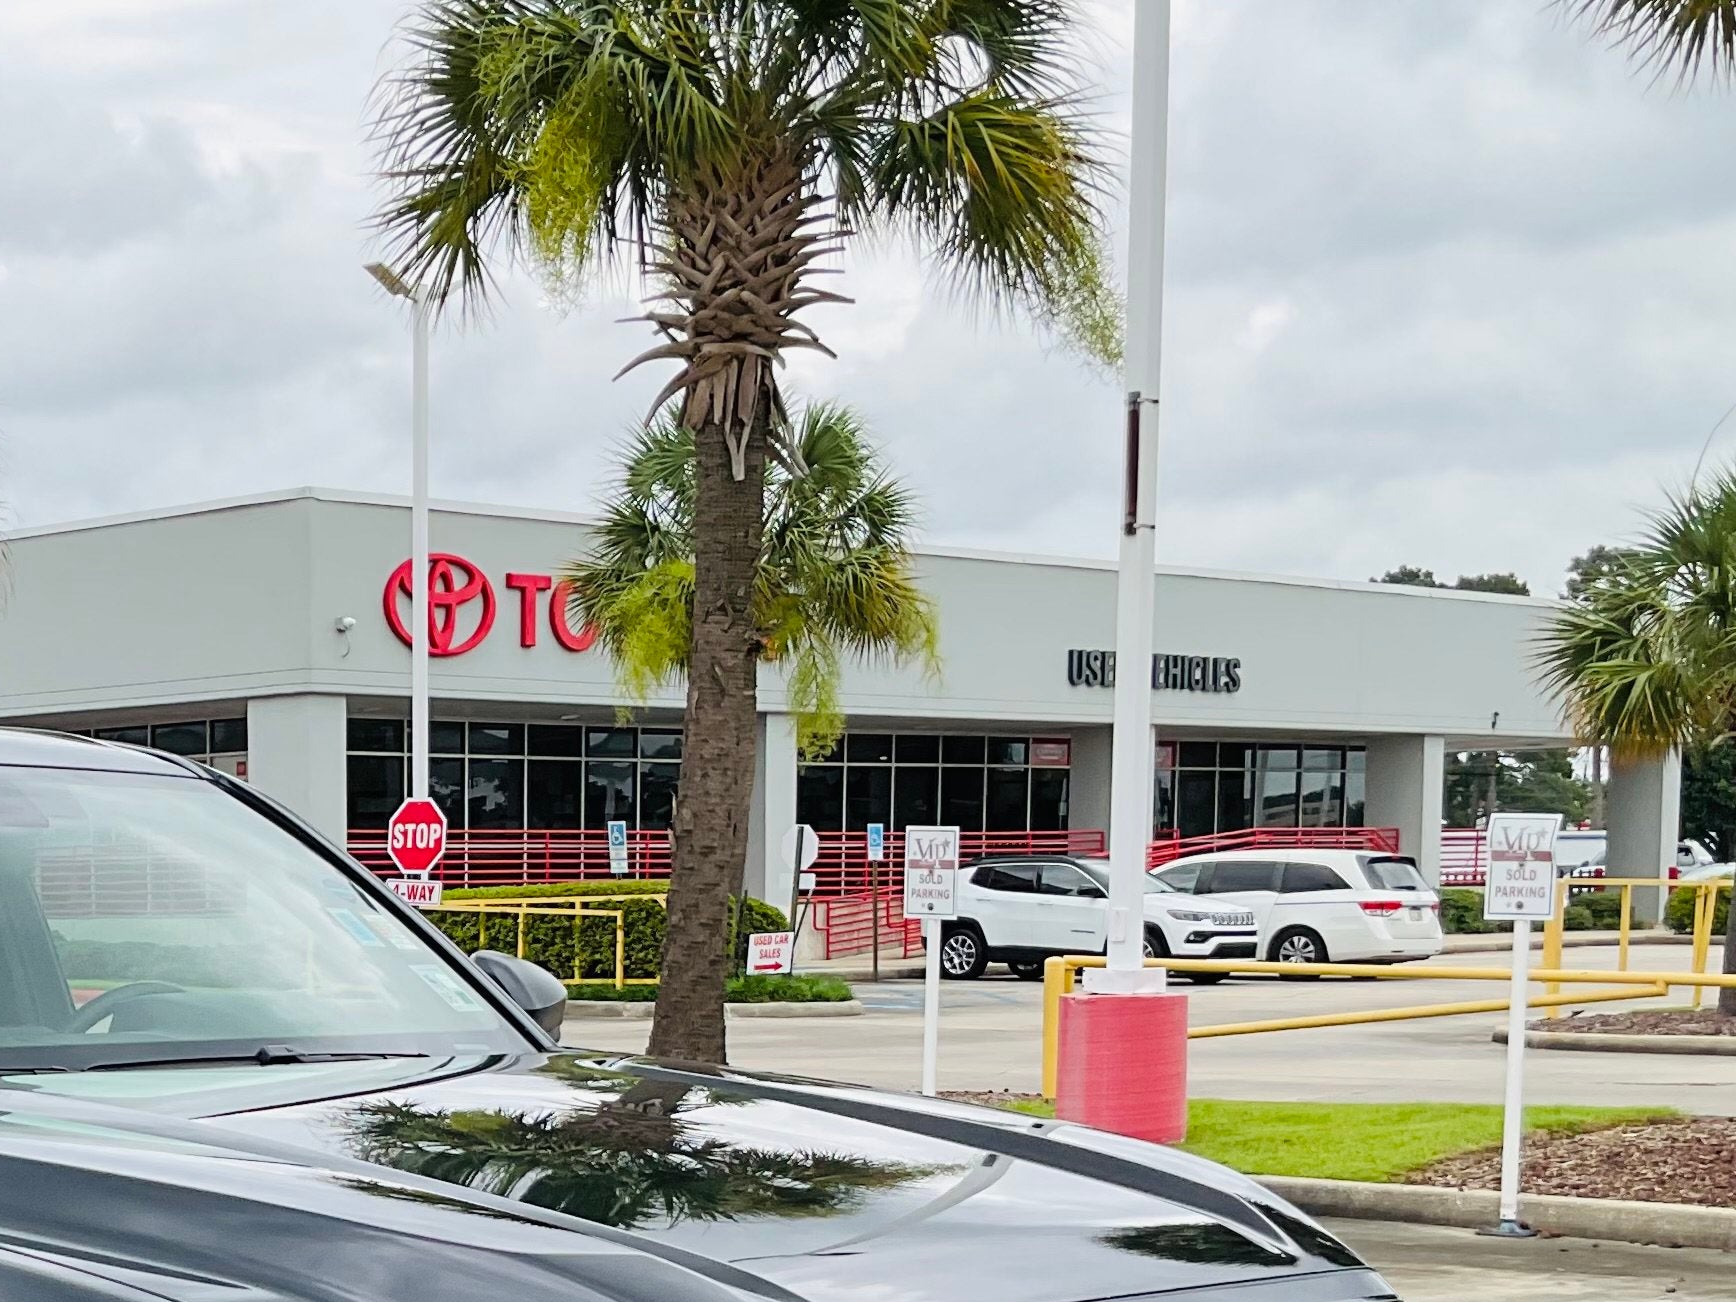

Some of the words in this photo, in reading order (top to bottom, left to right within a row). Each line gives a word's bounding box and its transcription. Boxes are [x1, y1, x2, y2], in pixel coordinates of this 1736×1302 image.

[1067, 649, 1117, 687] USE
[1151, 653, 1241, 693] EHICLES
[392, 823, 442, 849] STOP
[919, 873, 943, 884] SOLD
[1506, 869, 1536, 881] SOLD
[911, 888, 950, 900] PARKING
[1495, 886, 1546, 898] PARKING
[754, 935, 772, 946] USED
[775, 934, 789, 945] CAR
[759, 948, 781, 960] SALES
